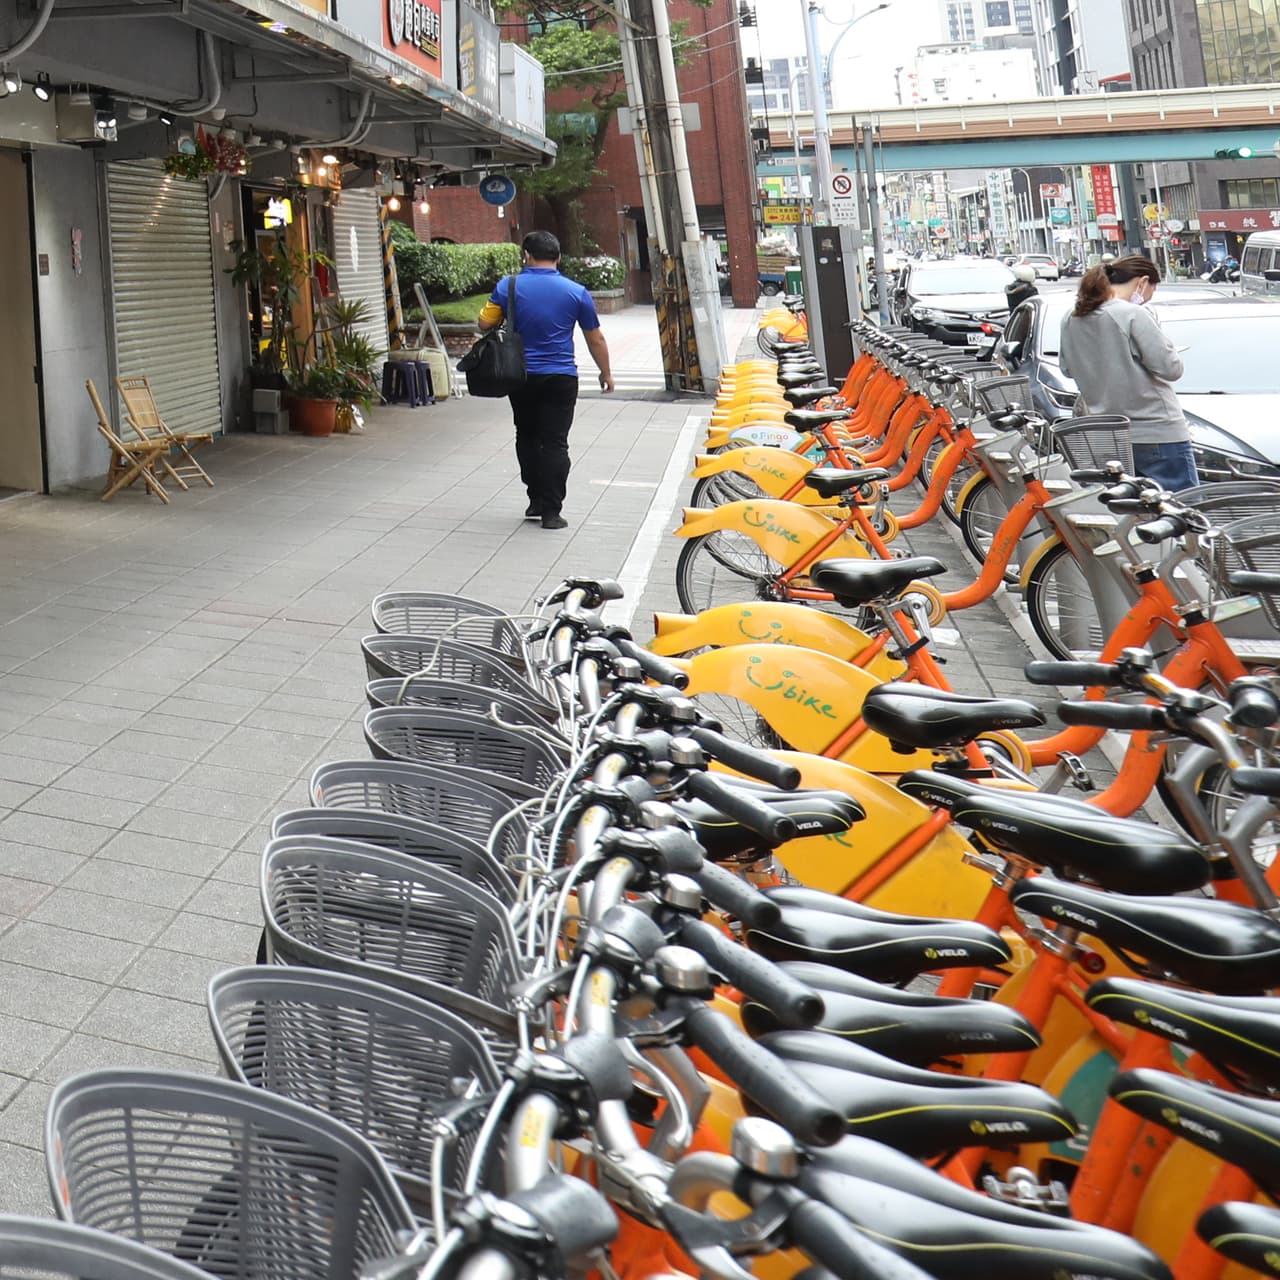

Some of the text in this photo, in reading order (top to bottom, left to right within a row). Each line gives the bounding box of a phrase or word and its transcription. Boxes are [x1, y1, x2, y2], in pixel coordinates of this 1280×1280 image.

[1064, 909, 1099, 929] VELO
[936, 947, 968, 958] VELO
[986, 1120, 1029, 1134] VELO
